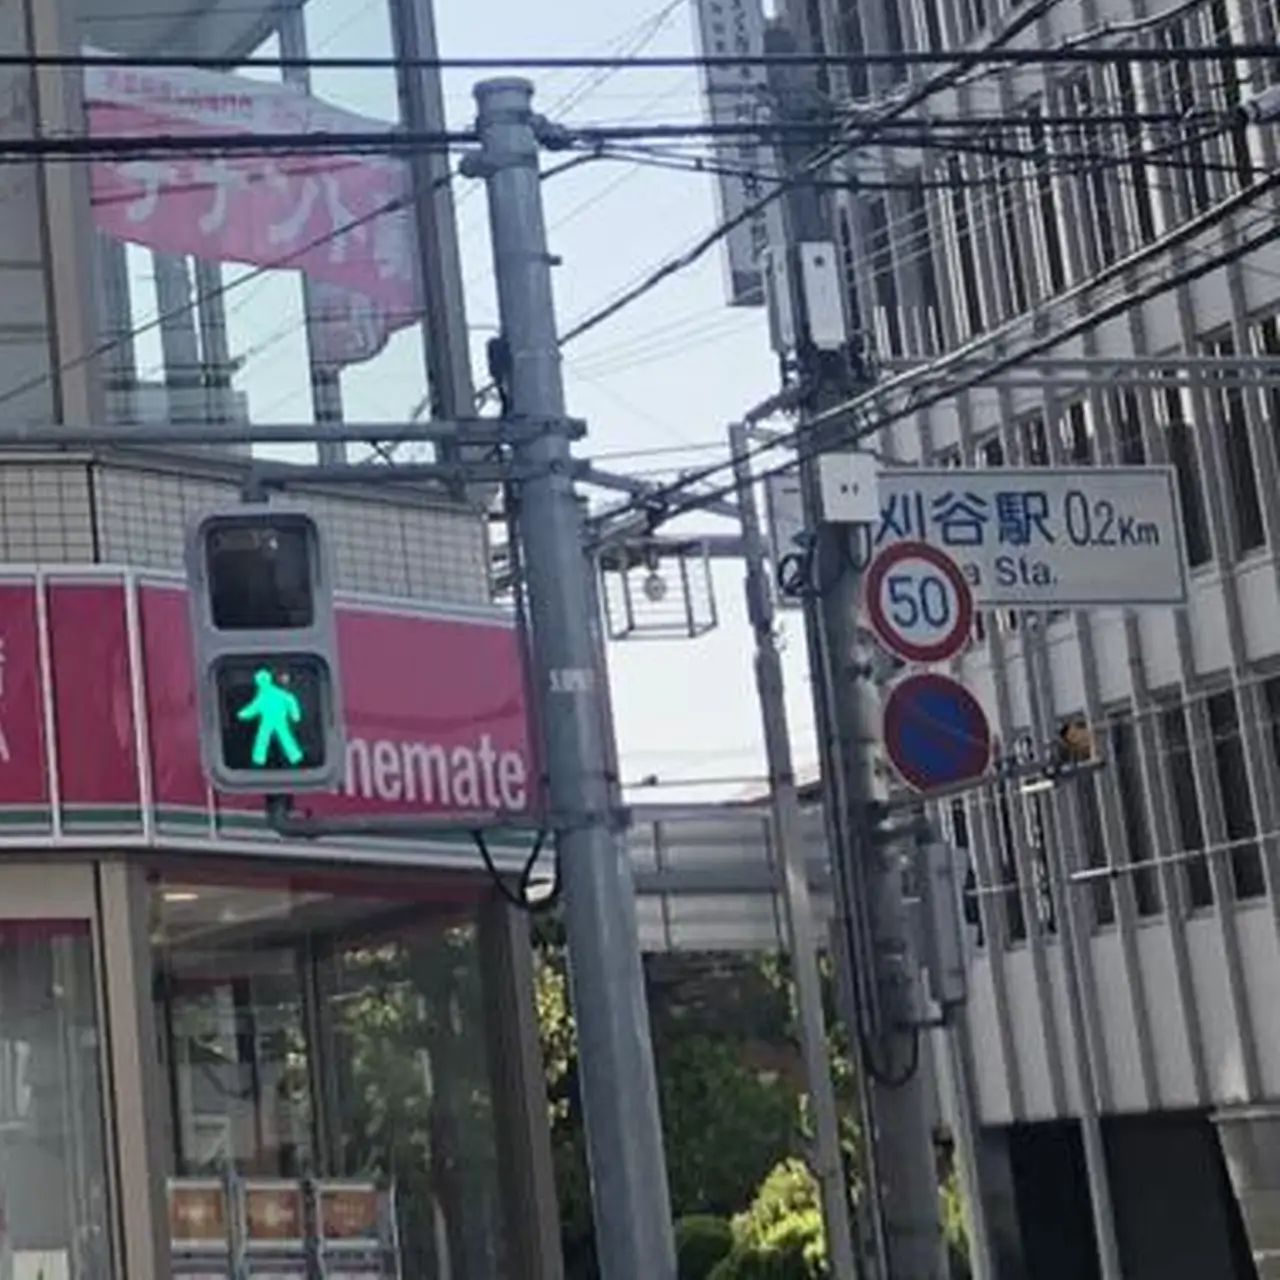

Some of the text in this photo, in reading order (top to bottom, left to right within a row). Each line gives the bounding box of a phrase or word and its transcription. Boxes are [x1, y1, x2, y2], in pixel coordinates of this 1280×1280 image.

[875, 490, 1057, 546] 刈谷駅
[887, 575, 950, 629] 50
